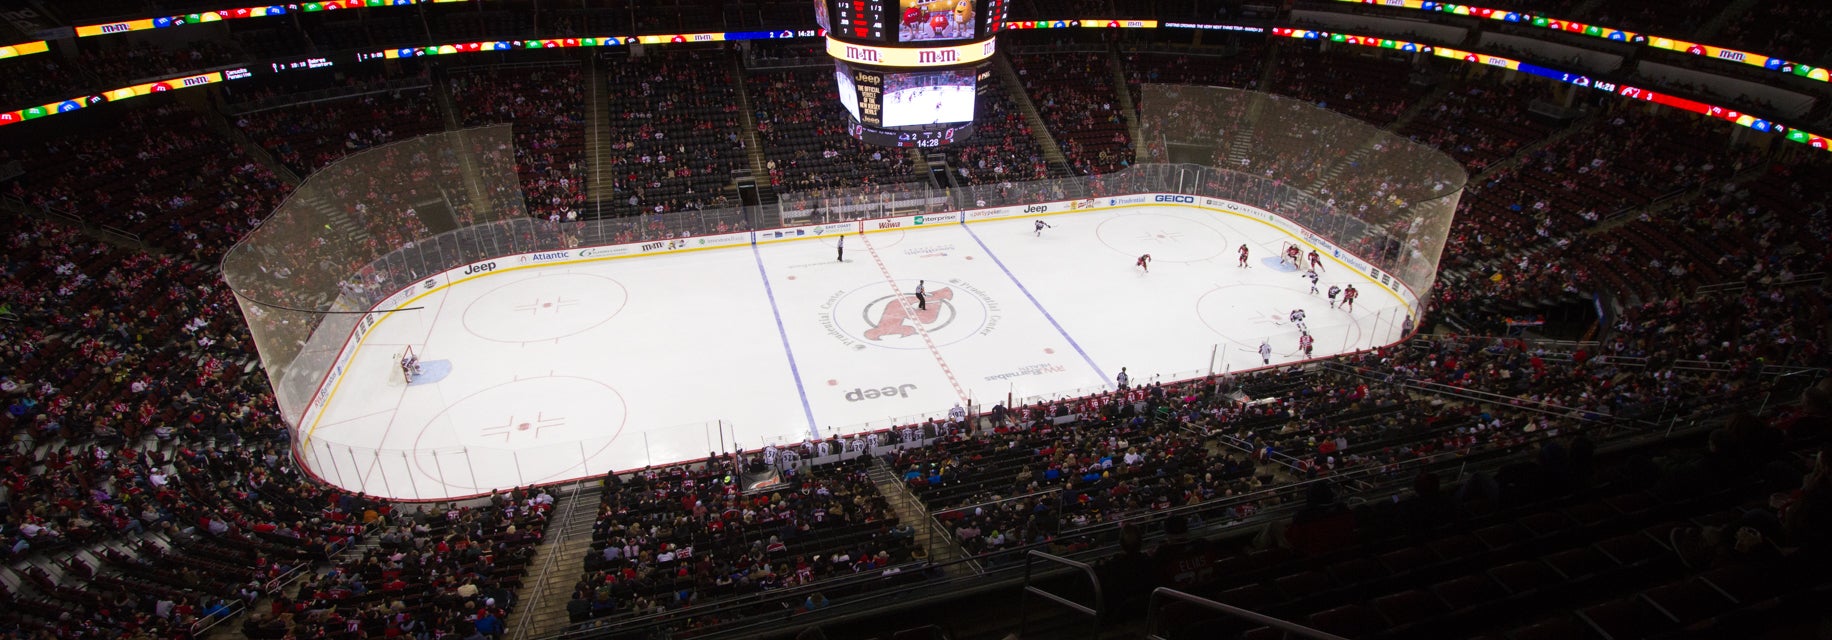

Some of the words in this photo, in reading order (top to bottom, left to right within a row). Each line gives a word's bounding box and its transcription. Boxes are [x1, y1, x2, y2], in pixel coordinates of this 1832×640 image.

[855, 72, 880, 85] Jeep
[1594, 81, 1615, 92] 14:28
[862, 116, 880, 124] Jeep
[917, 138, 939, 147] 14:28
[1155, 195, 1194, 203] GEICO
[1024, 204, 1047, 213] Jeep
[1240, 208, 1266, 218] INFINITI
[533, 252, 569, 261] Atlantic
[464, 261, 496, 275] Jeep
[1341, 254, 1367, 272] Prudential
[820, 290, 845, 309] Center
[960, 282, 1000, 311] Prudential
[980, 316, 1001, 336] Center
[818, 312, 854, 345] Prudential
[845, 384, 917, 402] Jeep
